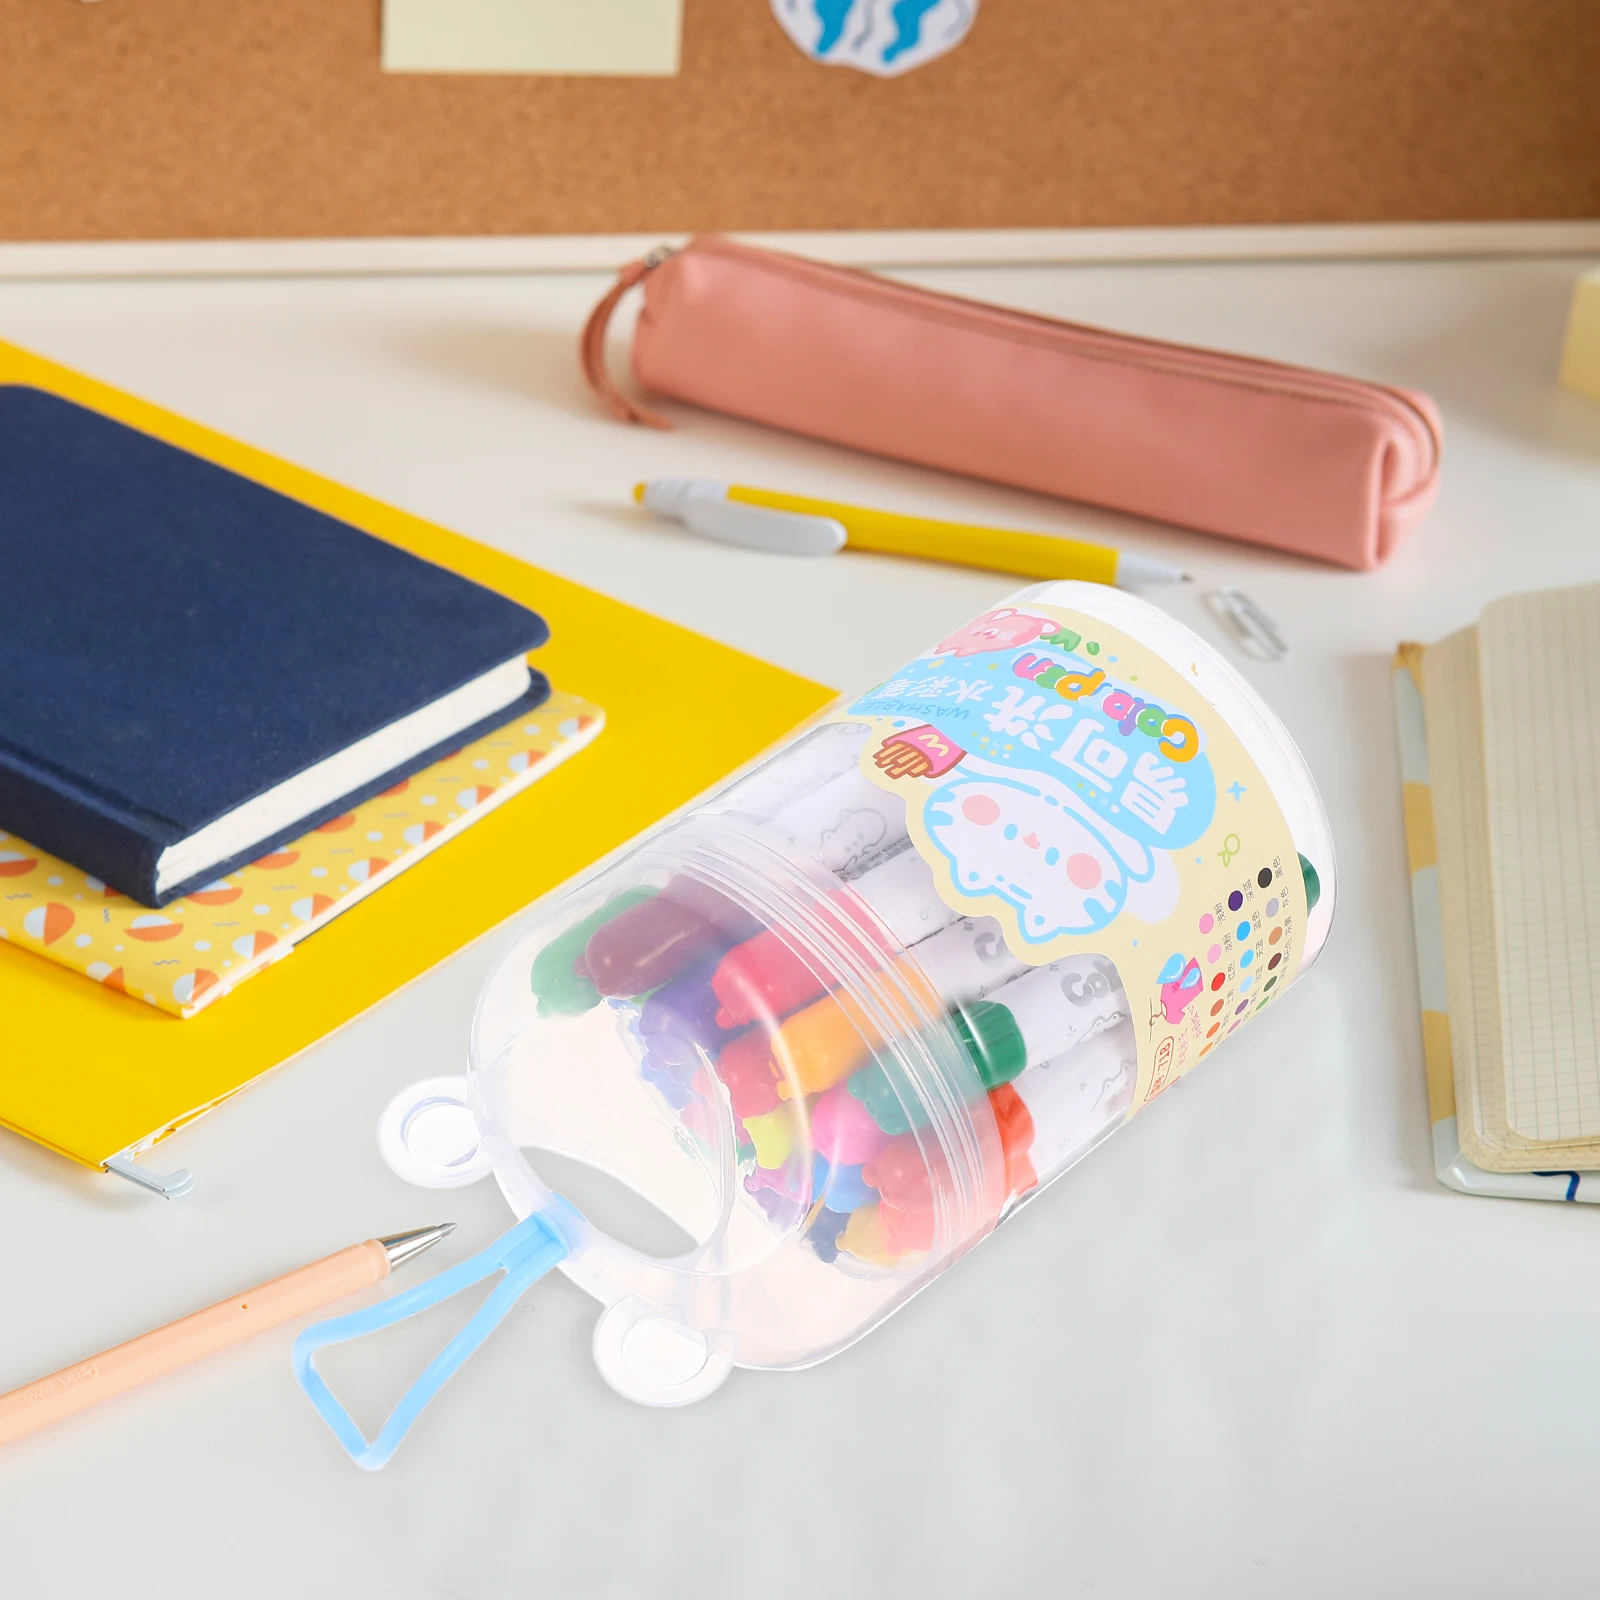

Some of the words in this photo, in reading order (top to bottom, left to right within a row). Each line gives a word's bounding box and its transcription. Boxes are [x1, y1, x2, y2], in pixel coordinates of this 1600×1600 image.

[1012, 653, 1106, 701] pen
[861, 700, 970, 719] WASHABLE
[1077, 683, 1199, 763] Color
[983, 685, 1188, 834] 易可洗
[22, 1383, 55, 1404] JAPAN
[58, 1364, 99, 1388] Pentel
